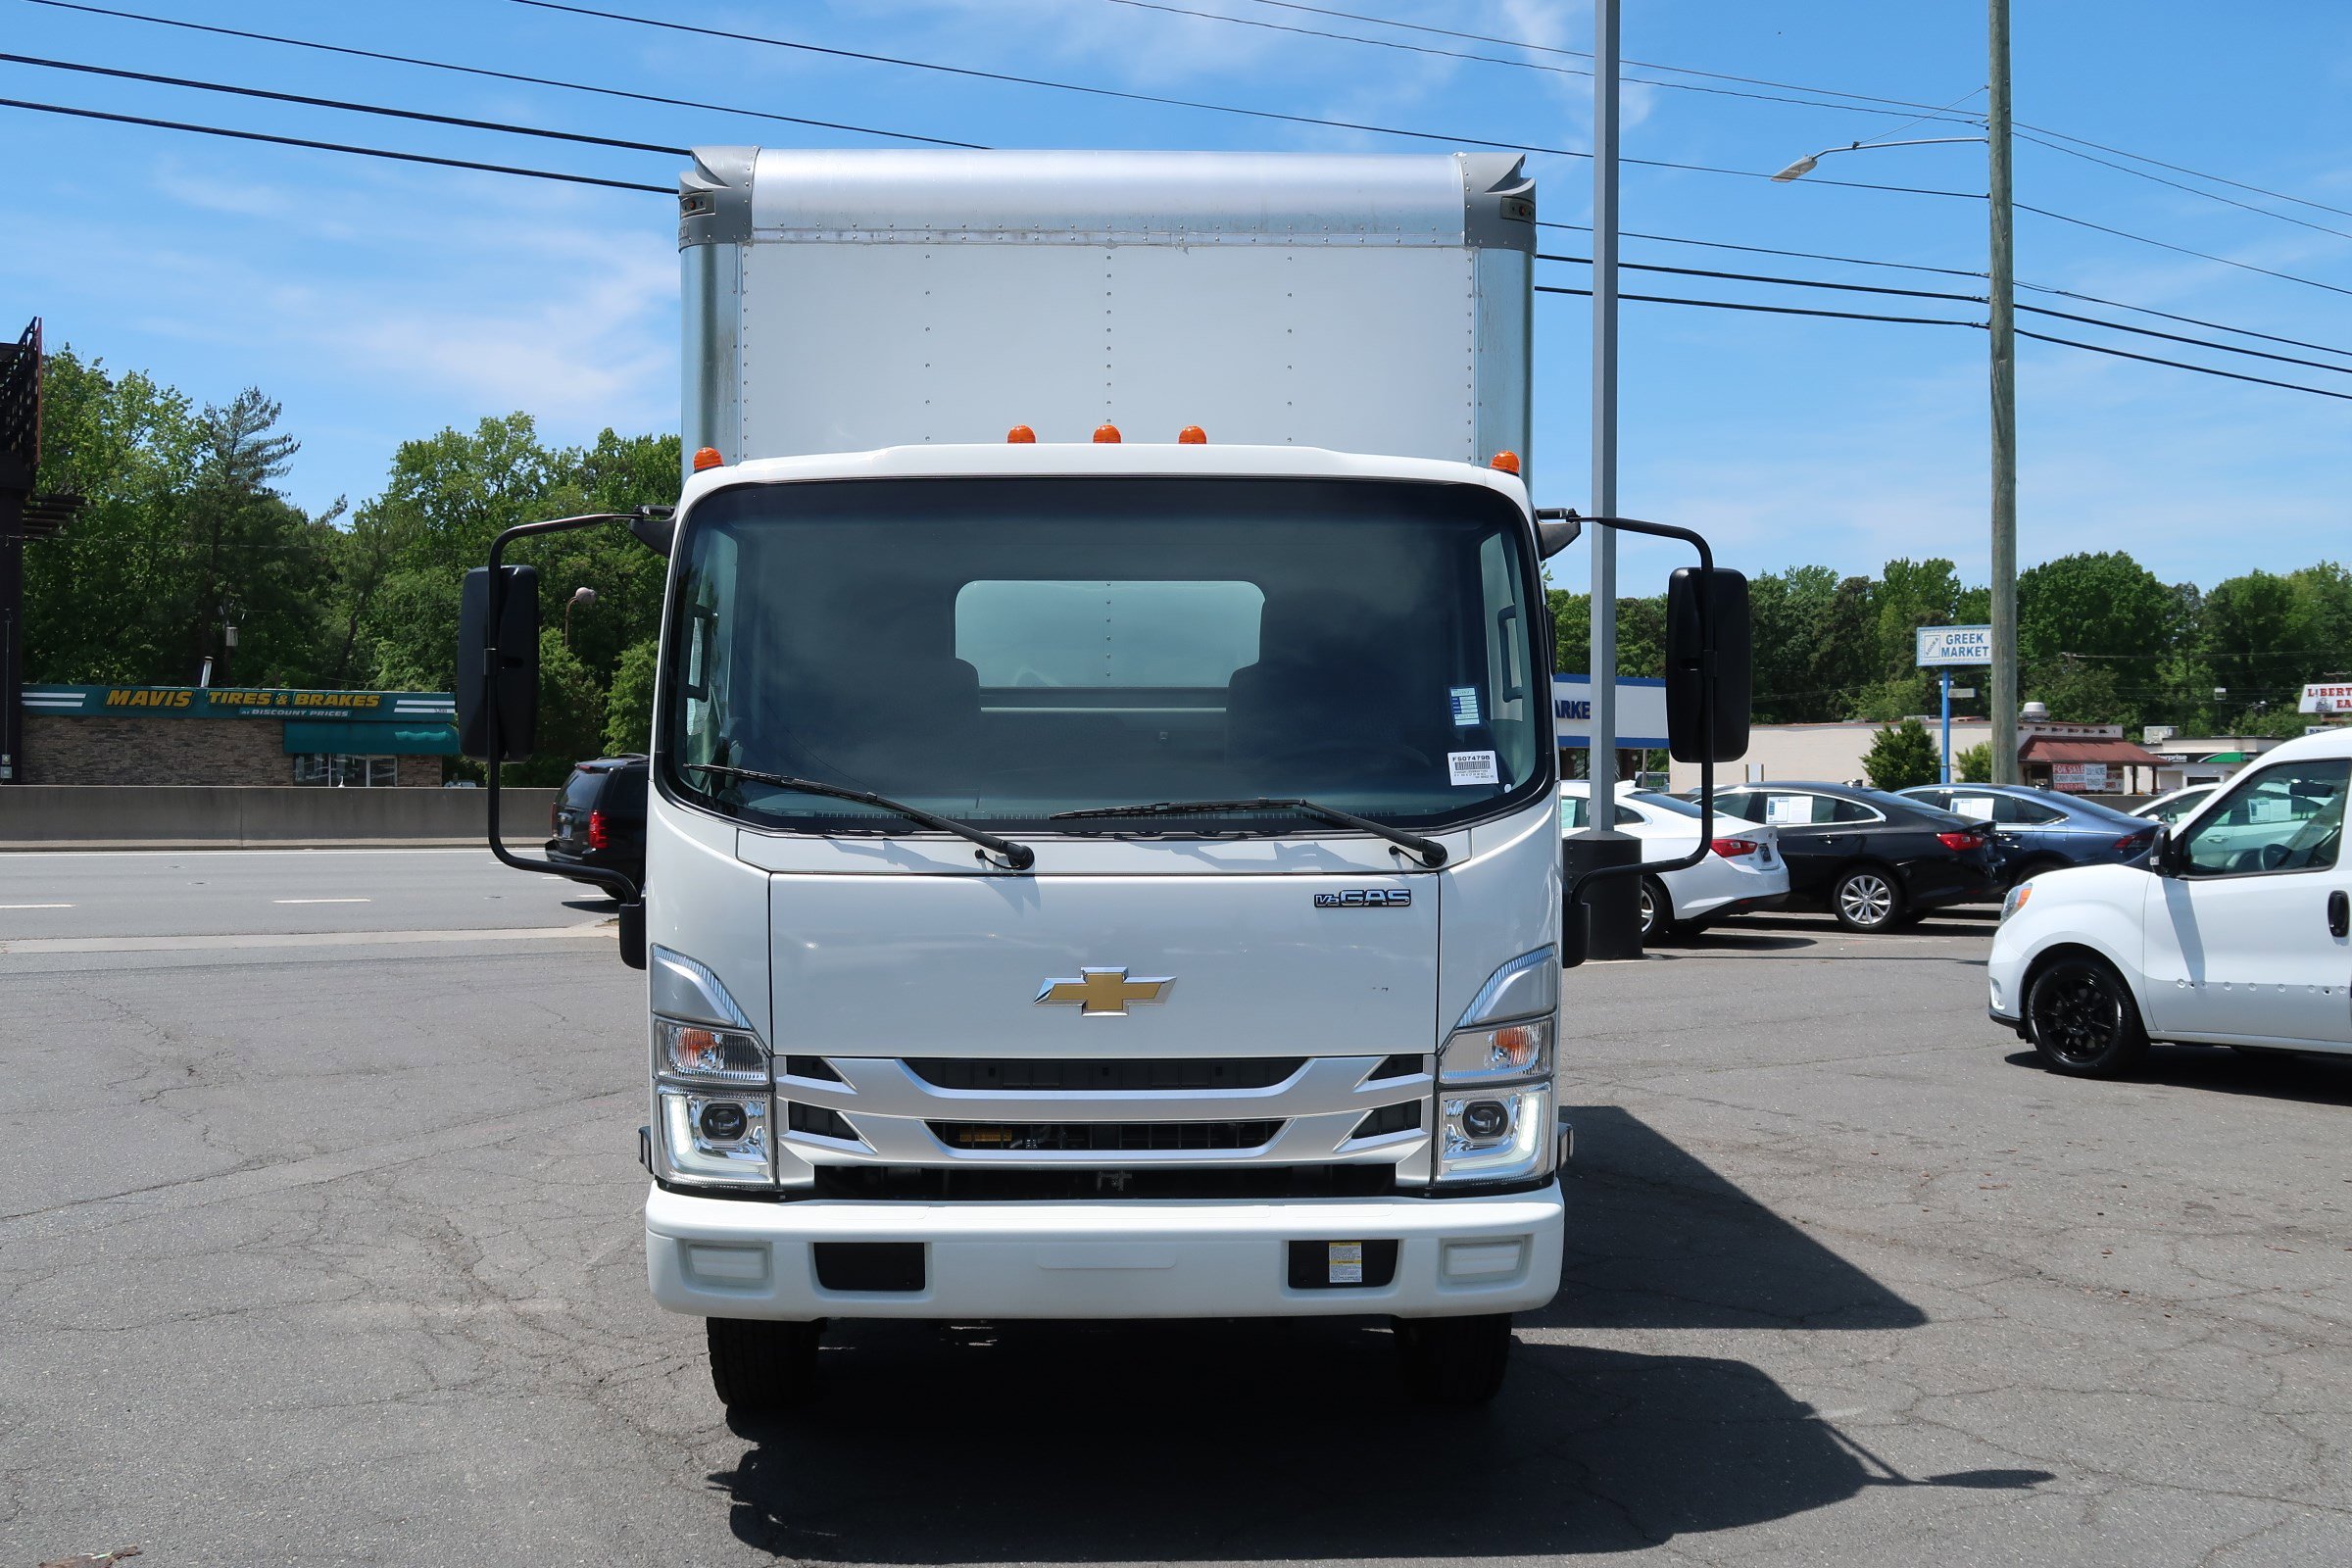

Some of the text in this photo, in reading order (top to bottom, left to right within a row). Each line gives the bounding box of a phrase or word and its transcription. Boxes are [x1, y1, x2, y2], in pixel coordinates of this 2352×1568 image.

[1946, 633, 1984, 645] GREEK
[1941, 646, 1989, 658] MARKET
[106, 689, 381, 708] MAVIS TIRES & BRAKES
[2053, 764, 2068, 774] FOR
[2070, 764, 2085, 774] SALE
[1341, 889, 1411, 906] GAS
